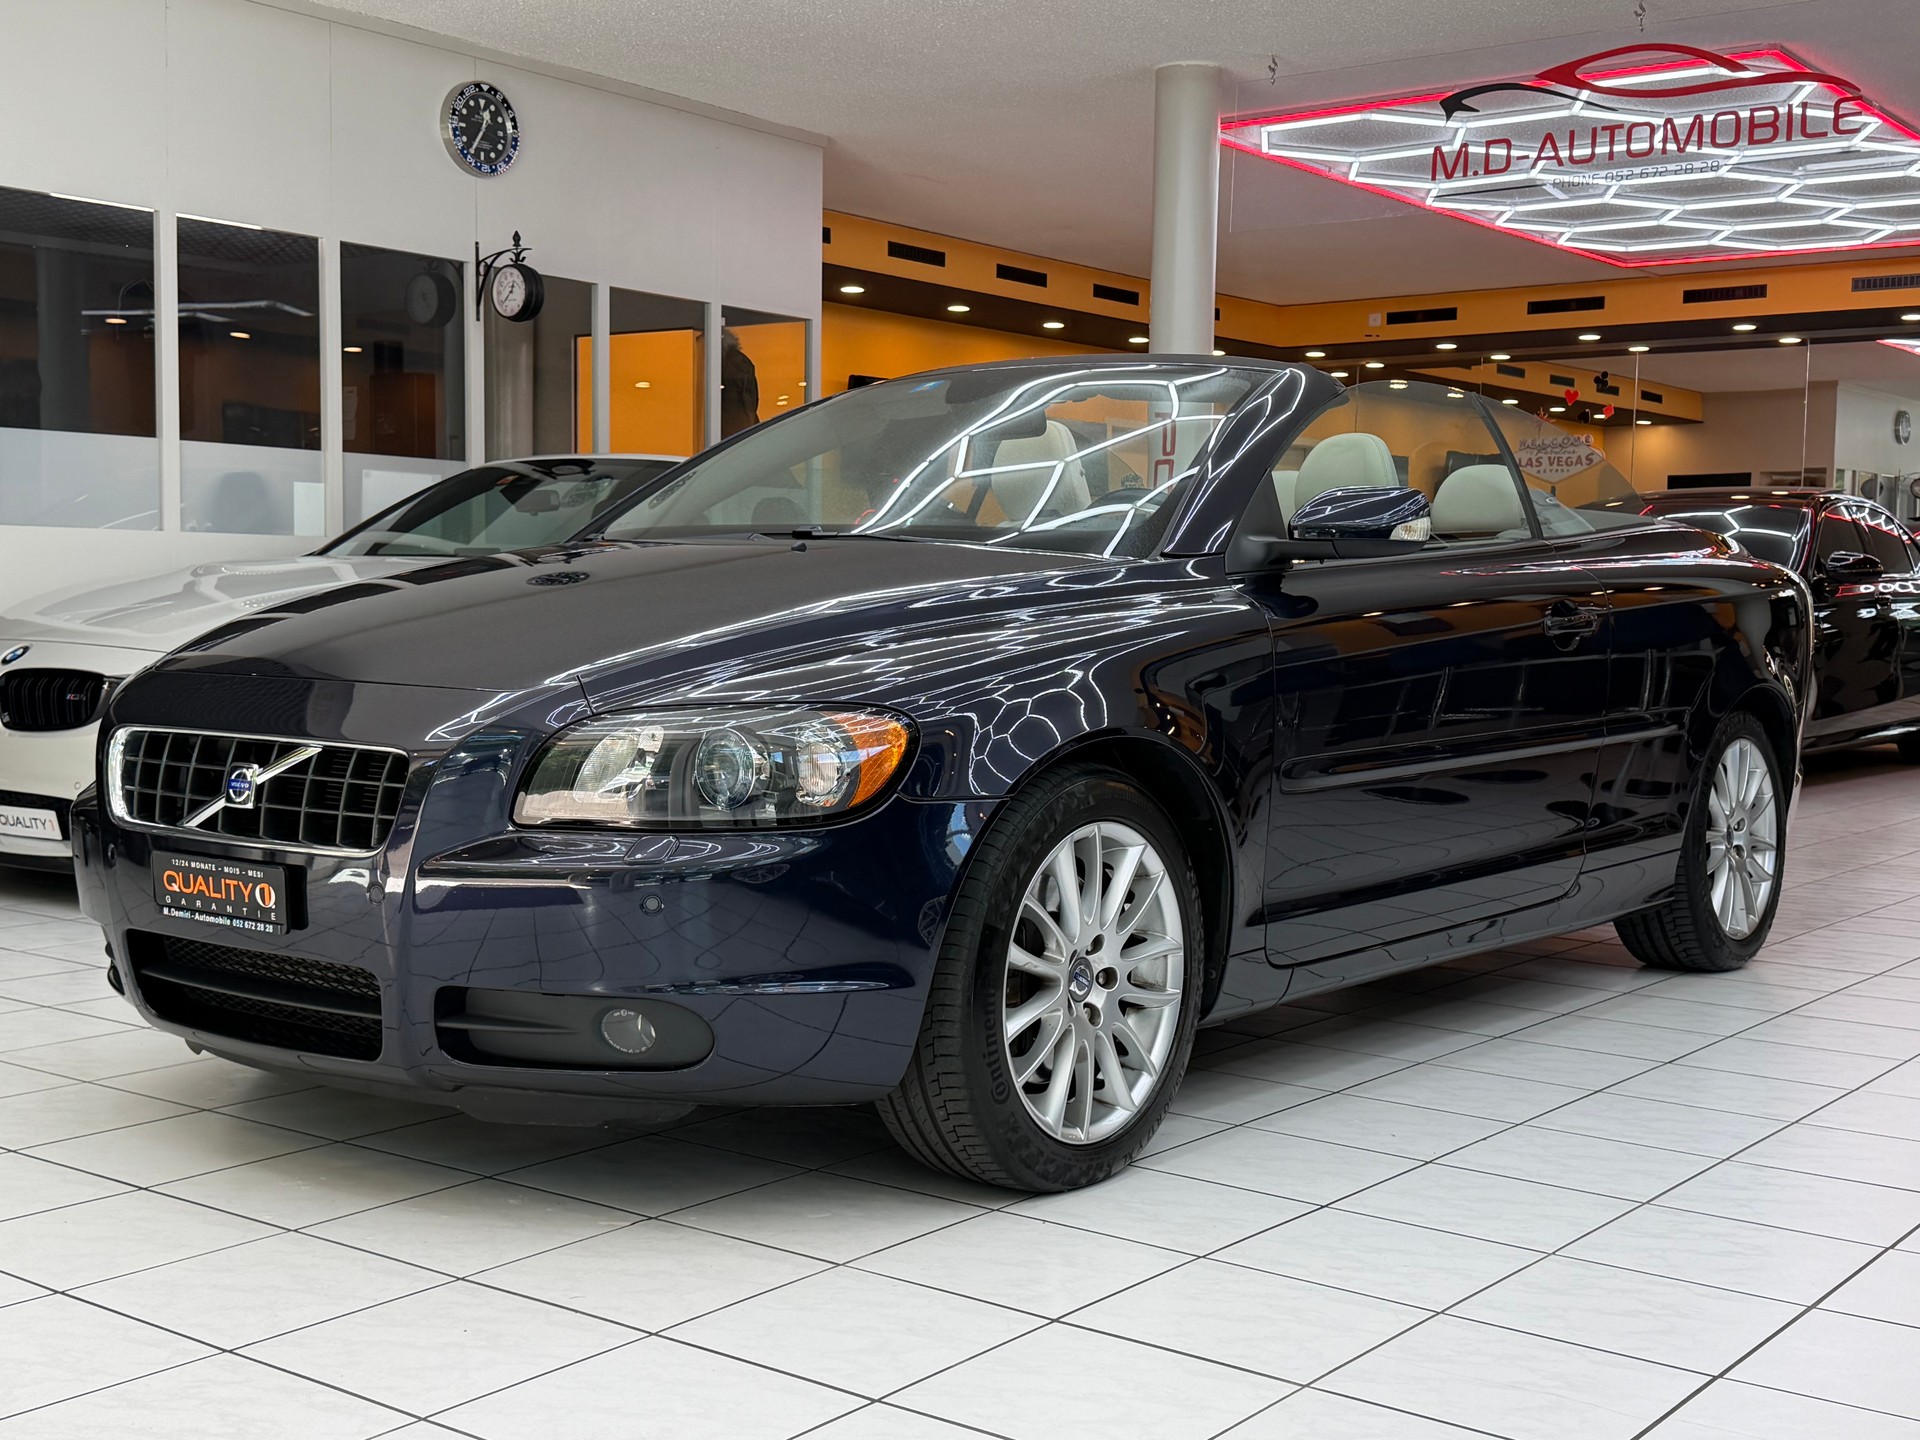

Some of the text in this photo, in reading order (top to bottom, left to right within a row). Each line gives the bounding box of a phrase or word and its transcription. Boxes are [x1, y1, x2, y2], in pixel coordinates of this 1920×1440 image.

[464, 84, 476, 96] 22
[496, 92, 504, 101] 2
[454, 95, 464, 110] 20
[508, 110, 515, 118] 4
[1431, 96, 1863, 181] M.D-AUTOMOBILE
[466, 154, 476, 167] 14
[1553, 160, 1720, 187] PHONE 052 672 28 28
[1518, 453, 1594, 468] LAS VEGAS
[172, 859, 189, 868] 12/24
[190, 860, 216, 871] MONATE
[224, 866, 240, 875] MOIS
[247, 869, 264, 878] MESI
[163, 870, 253, 903] QUALITY
[165, 895, 276, 921] GARANTIE
[232, 919, 244, 928] 052
[244, 921, 256, 930] 672
[256, 922, 265, 931] 28
[265, 924, 274, 933] 28
